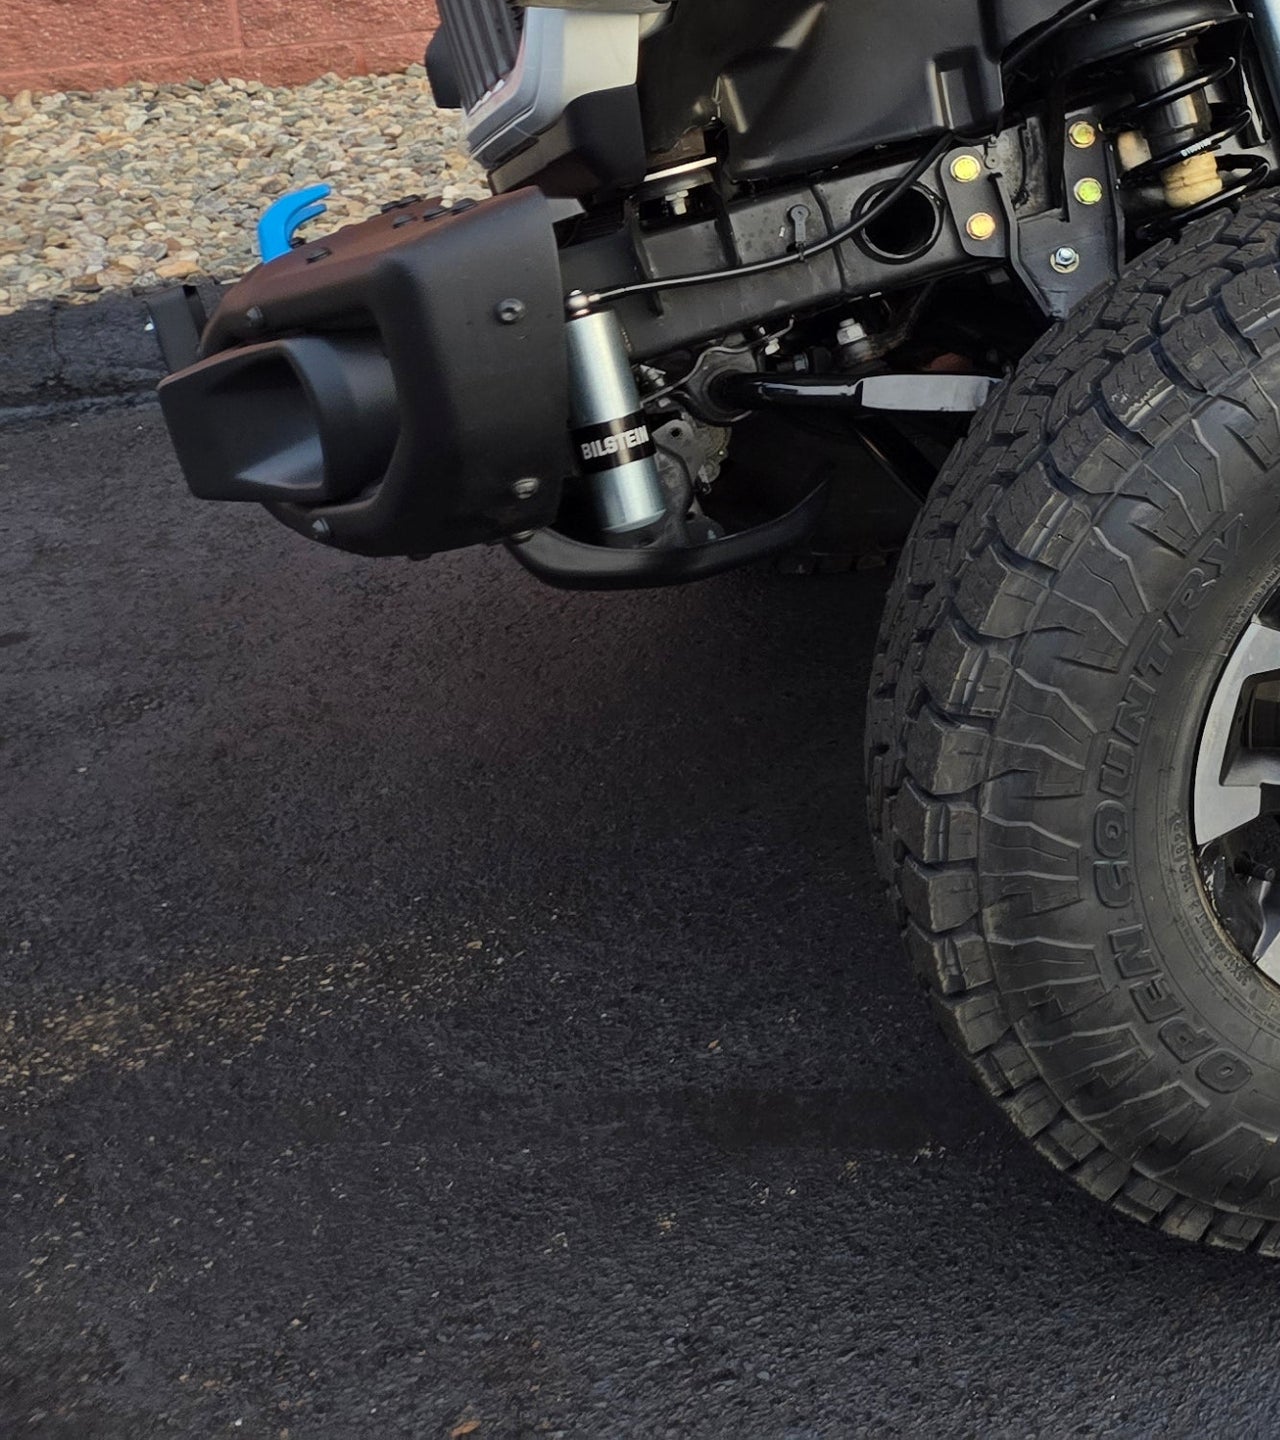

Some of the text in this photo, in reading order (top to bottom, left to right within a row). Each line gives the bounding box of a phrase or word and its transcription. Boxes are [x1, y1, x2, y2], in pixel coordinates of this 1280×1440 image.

[580, 424, 650, 460] BILSTEIN
[1091, 512, 1246, 909] COUNTRY
[1108, 922, 1255, 1097] OPEN
